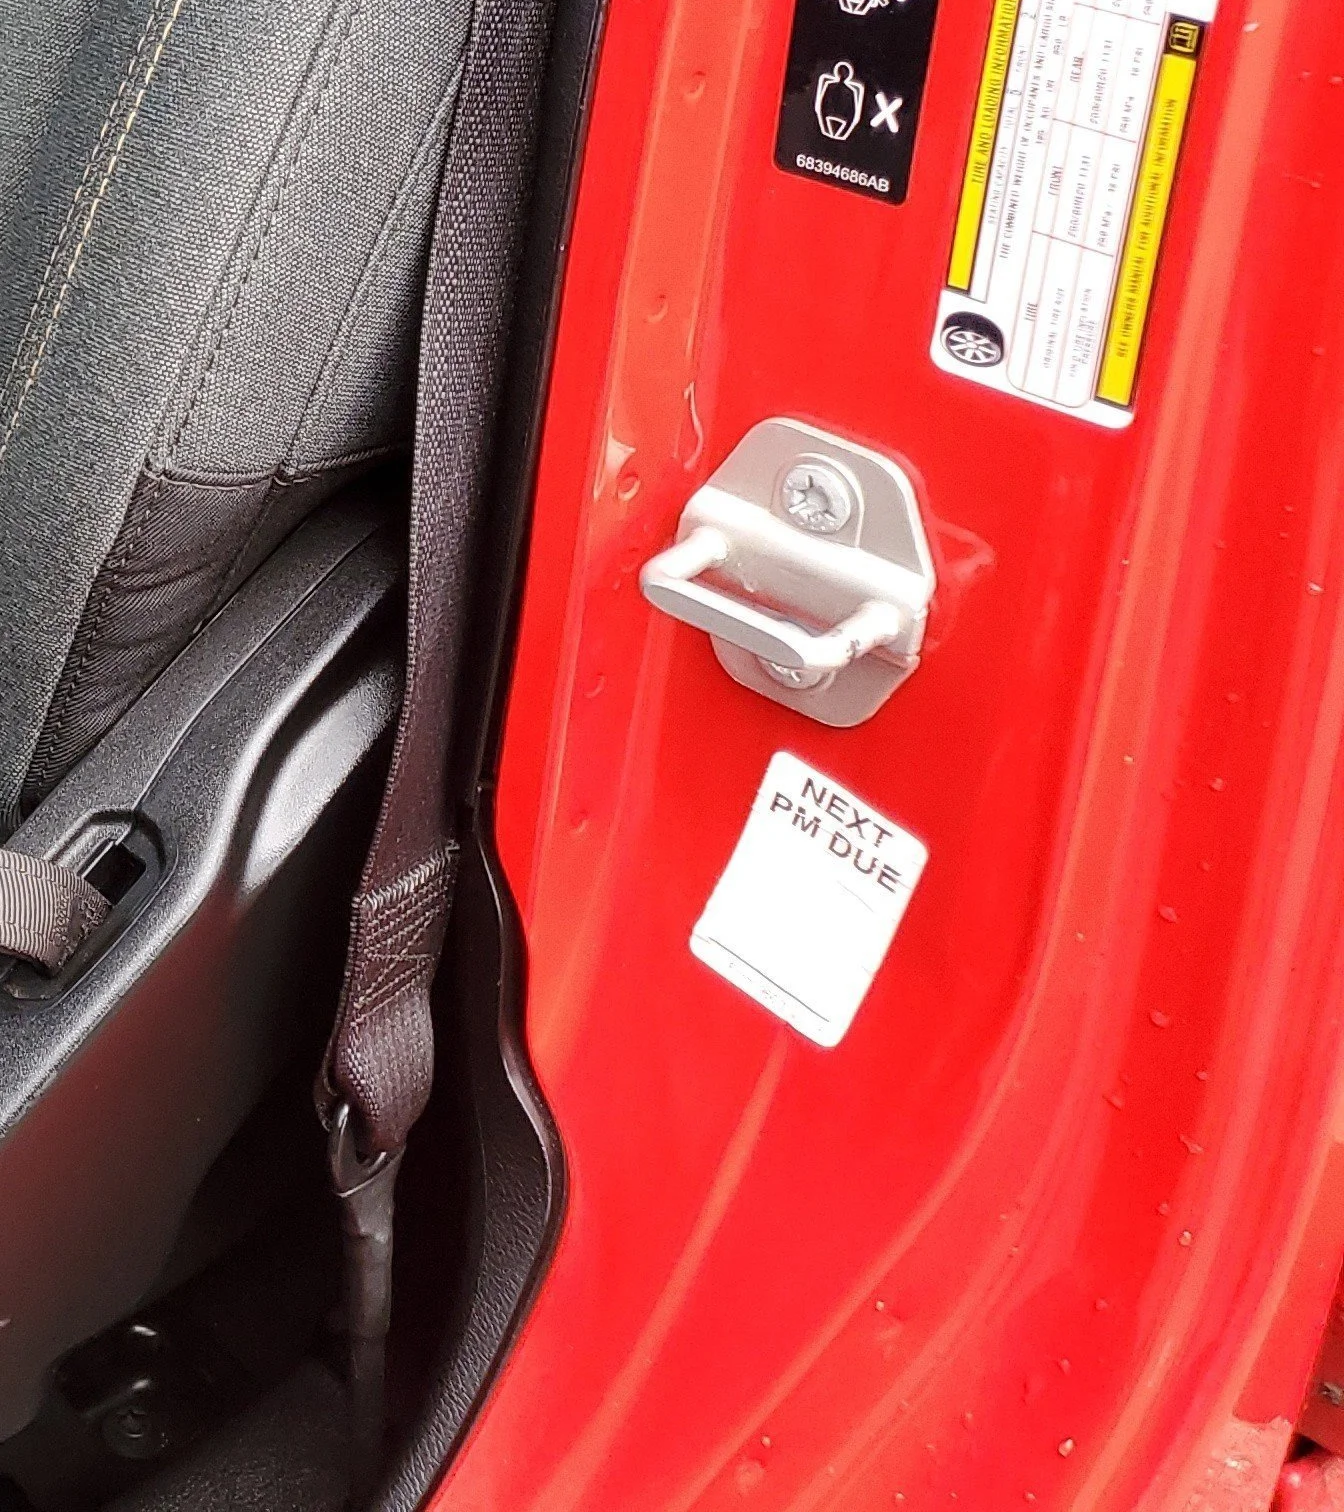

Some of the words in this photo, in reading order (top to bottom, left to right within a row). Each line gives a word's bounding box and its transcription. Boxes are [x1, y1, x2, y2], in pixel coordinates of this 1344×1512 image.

[980, 76, 1003, 128] LOADING
[976, 131, 992, 156] AND
[796, 154, 889, 192] 68394686AB
[801, 778, 893, 848] NEXT
[770, 792, 821, 837] PM
[828, 831, 901, 894] DUE
